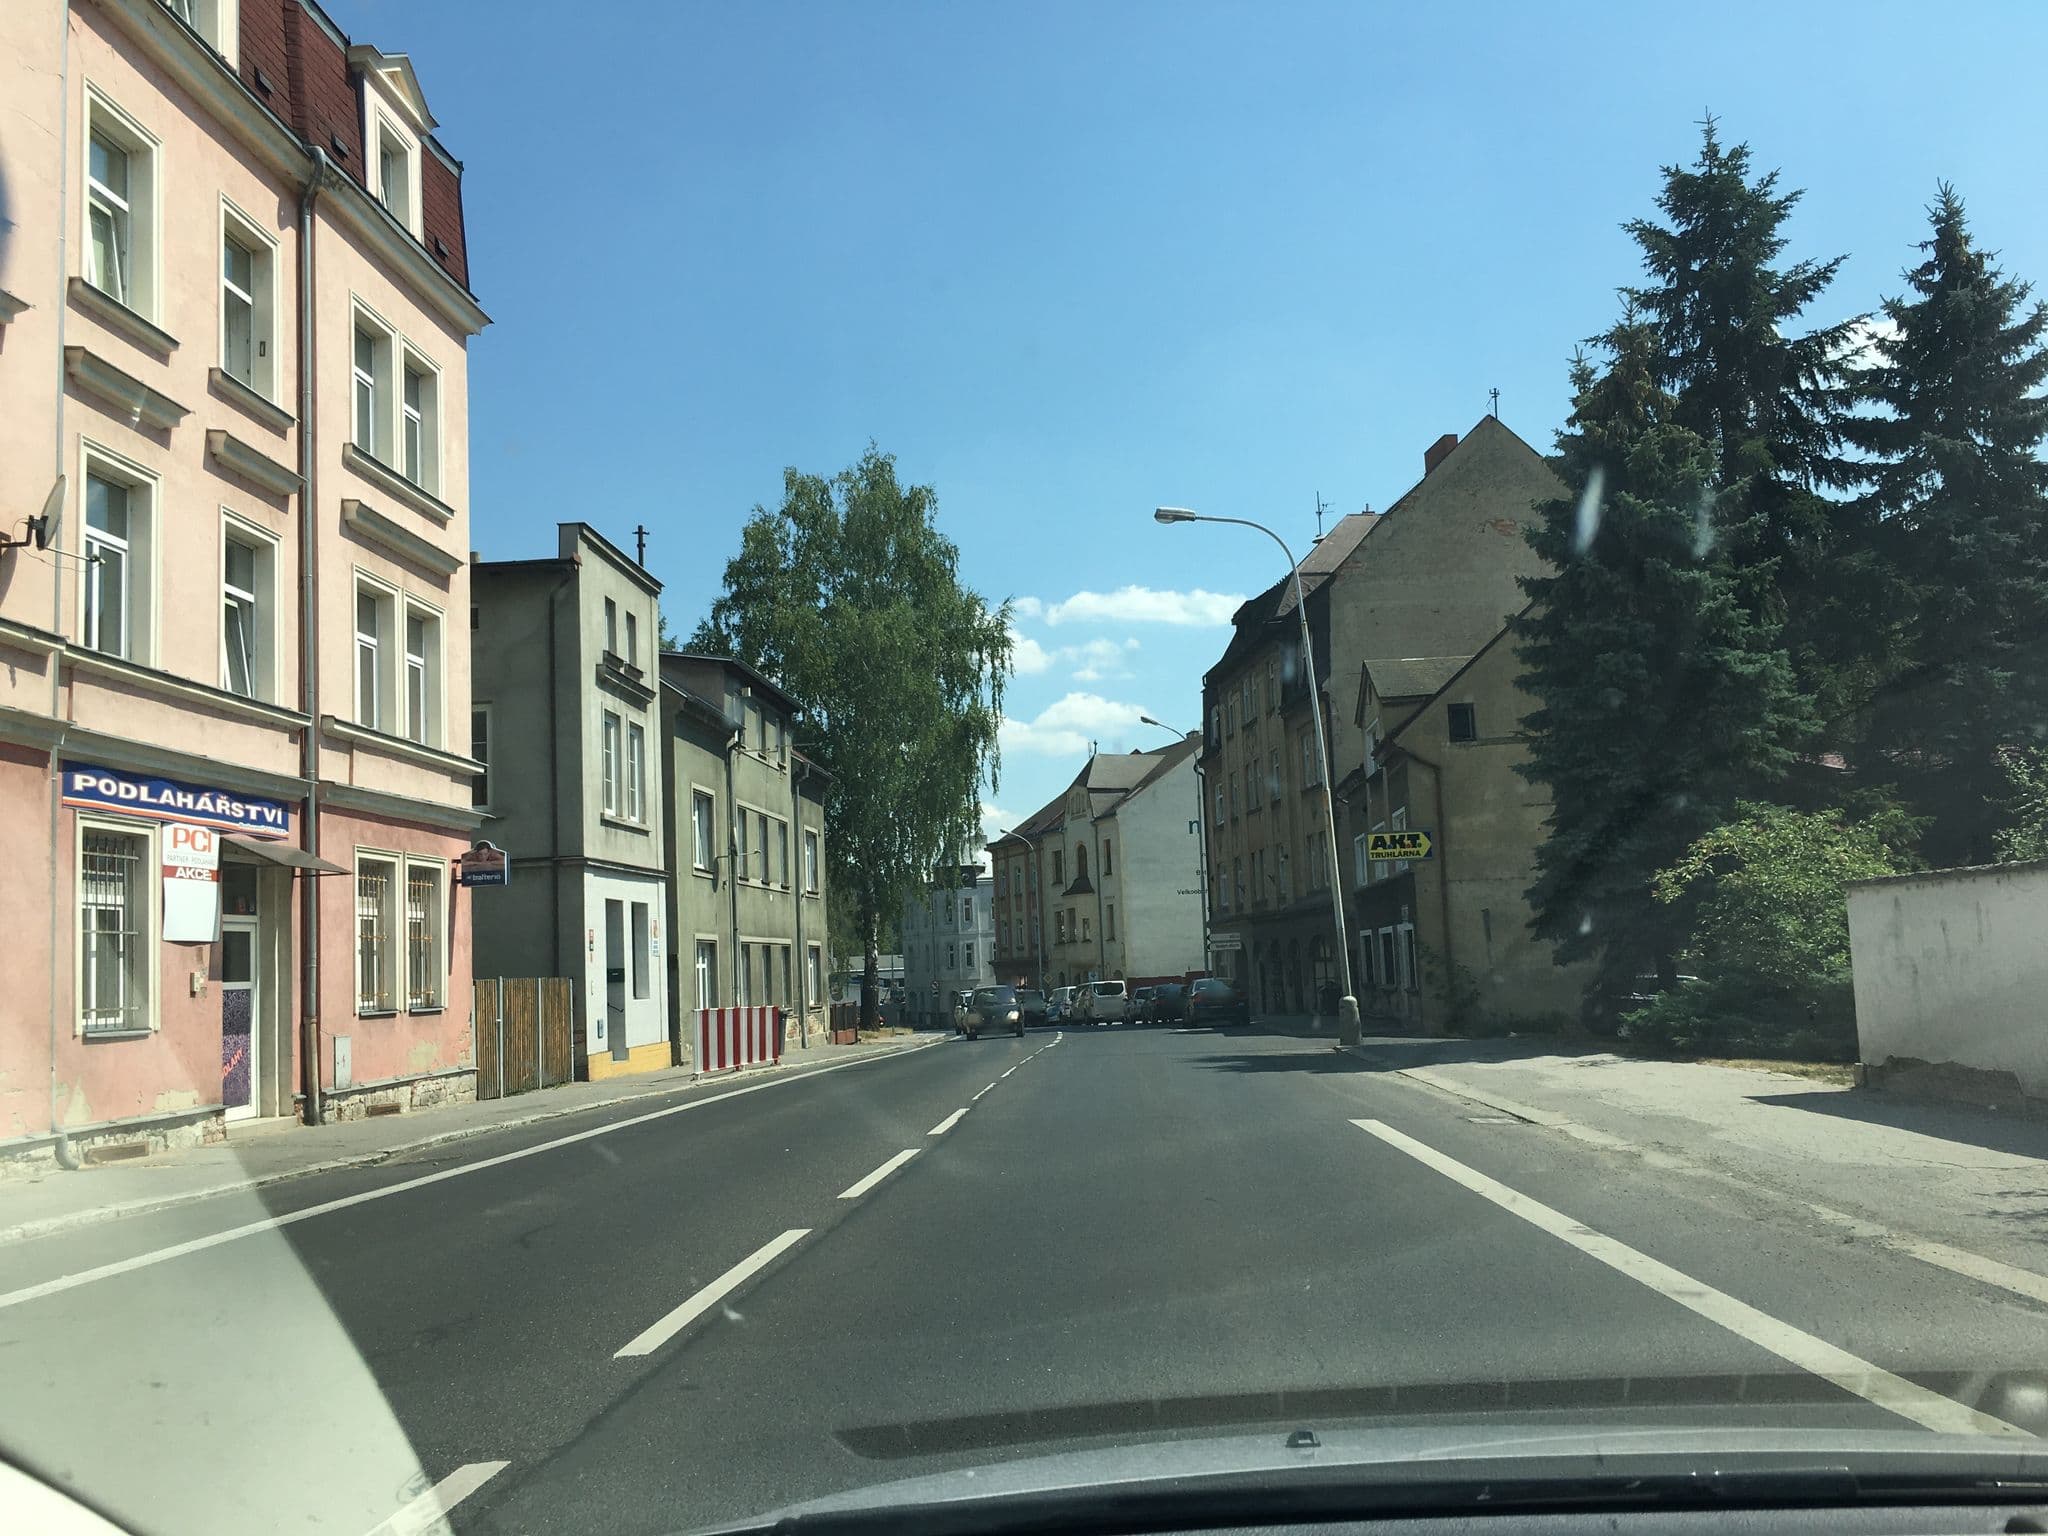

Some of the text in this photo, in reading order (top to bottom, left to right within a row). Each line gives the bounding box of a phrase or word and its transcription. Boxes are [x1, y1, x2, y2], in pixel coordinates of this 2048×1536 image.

[73, 774, 283, 825] PODLAHÁŘSTVÍ
[172, 826, 212, 853] PCI
[175, 867, 212, 880] AKCE
